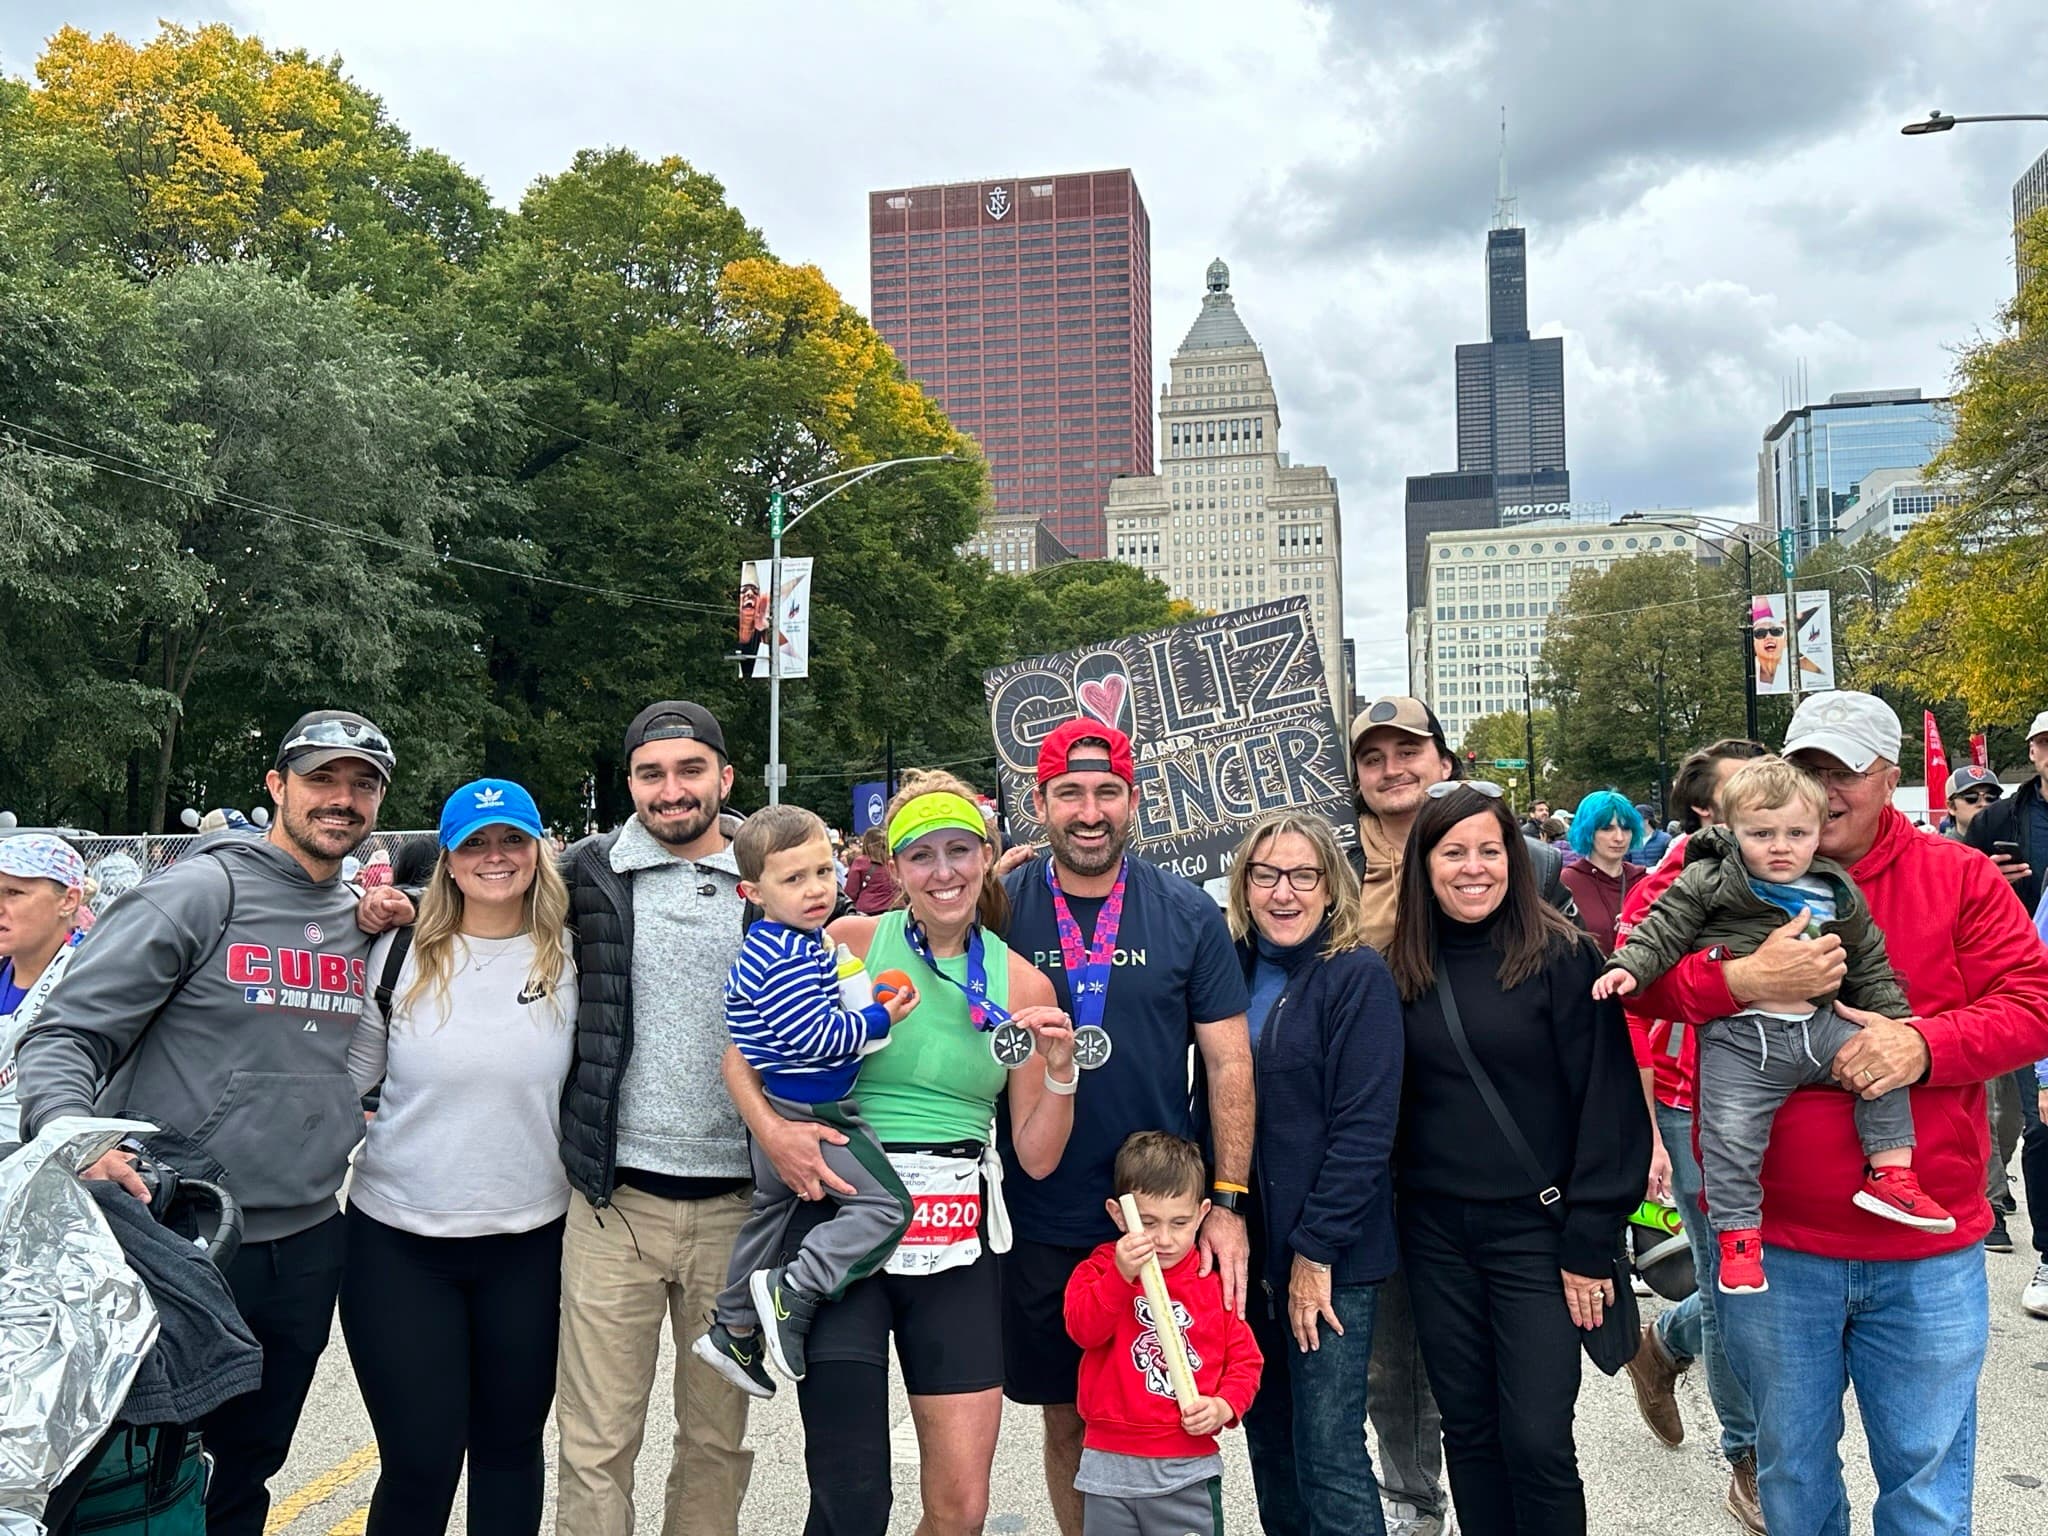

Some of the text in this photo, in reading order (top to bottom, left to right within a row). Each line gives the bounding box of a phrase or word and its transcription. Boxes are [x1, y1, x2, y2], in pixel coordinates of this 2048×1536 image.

[1784, 533, 1794, 573] J310
[1148, 610, 1322, 737] LIZ
[1141, 736, 1194, 760] AND
[227, 943, 365, 996] CUBS
[1034, 948, 1147, 968] PEON
[309, 993, 331, 1012] MLB
[896, 1170, 920, 1179] icago
